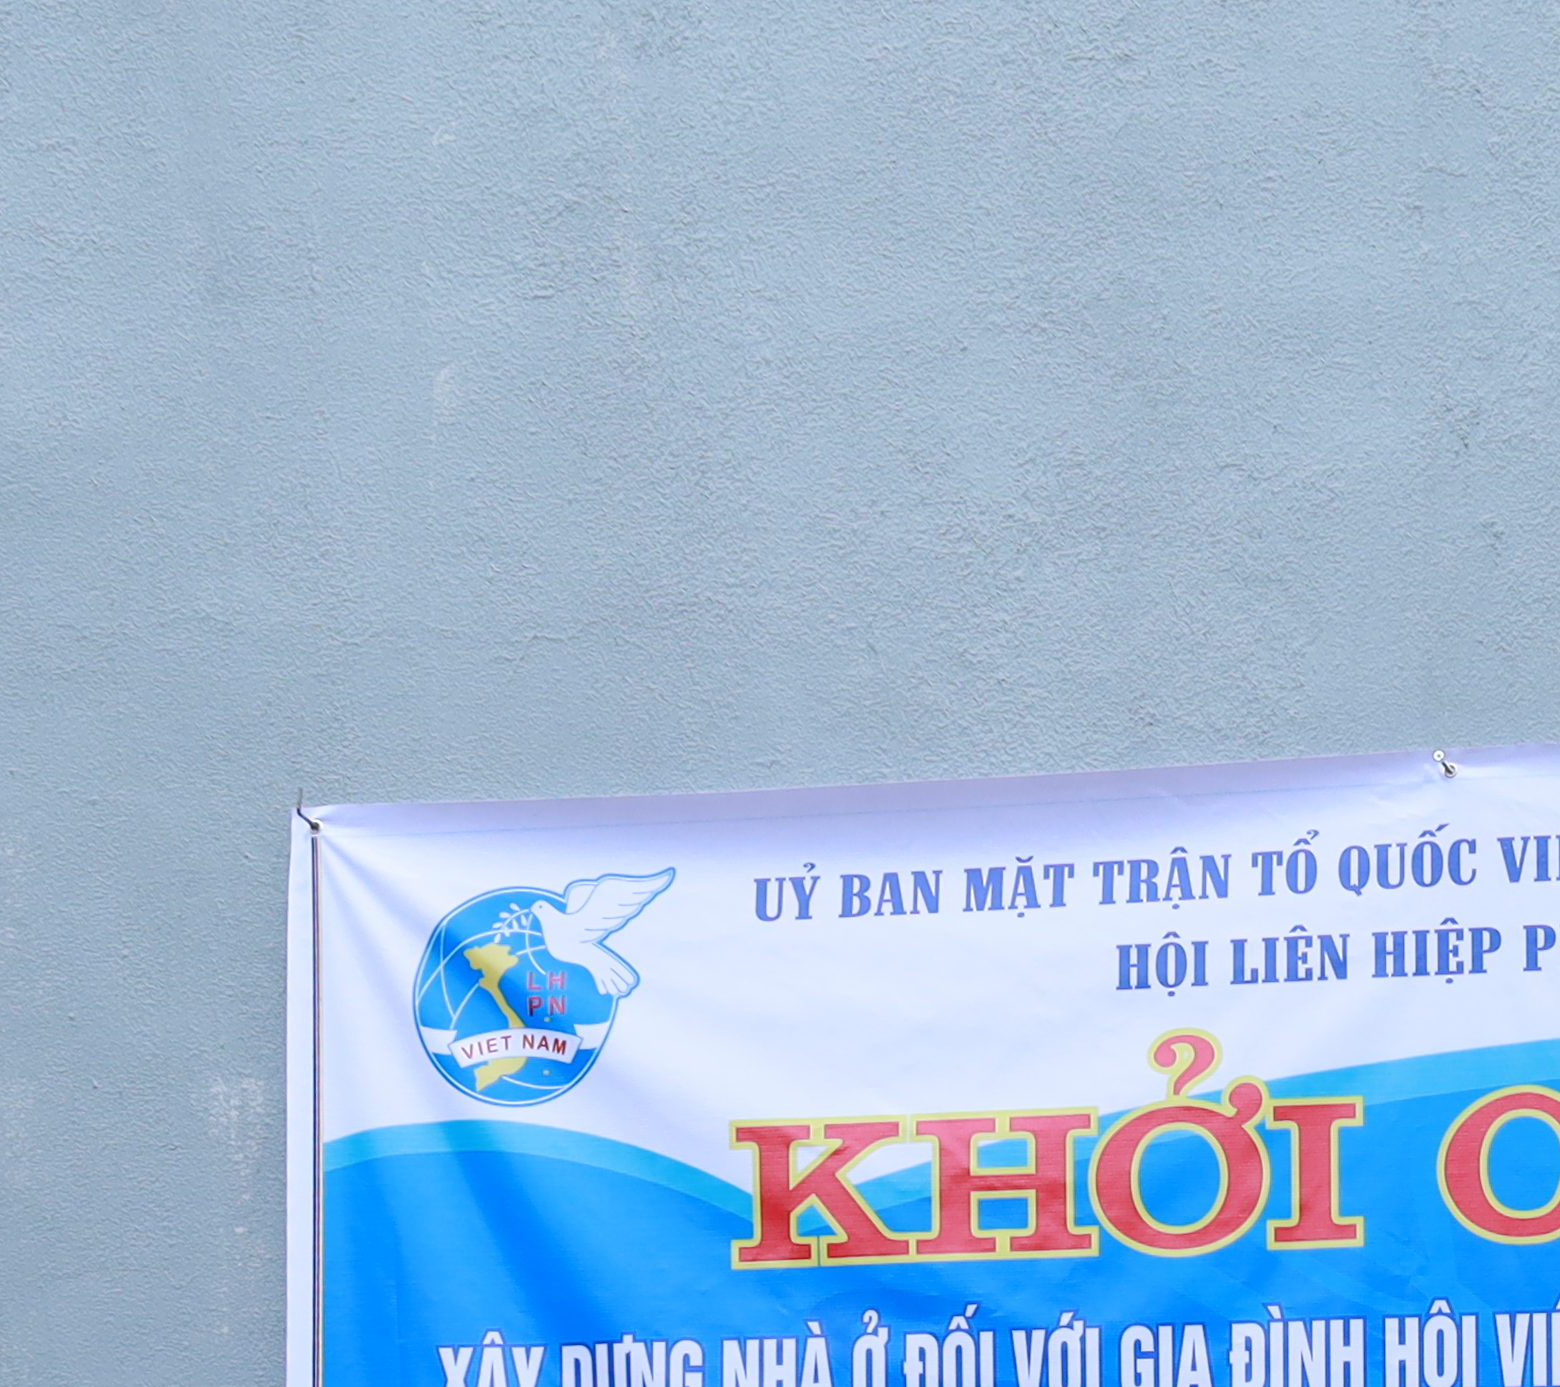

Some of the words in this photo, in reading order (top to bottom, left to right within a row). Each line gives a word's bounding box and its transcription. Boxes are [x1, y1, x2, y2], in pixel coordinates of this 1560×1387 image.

[754, 862, 821, 921] UỶ
[838, 870, 943, 917] BAN
[963, 856, 1074, 918] MẶT
[1093, 846, 1232, 910] TRẬN
[1251, 829, 1320, 896] TỔ
[1338, 824, 1477, 896] QUỐC
[1116, 931, 1209, 997] HỘI
[1229, 925, 1349, 985] LIÊN
[1371, 918, 1501, 984] HIỆP
[460, 1034, 512, 1059] VIET
[522, 1033, 568, 1056] NAM
[729, 1027, 1364, 1270] KHỞI
